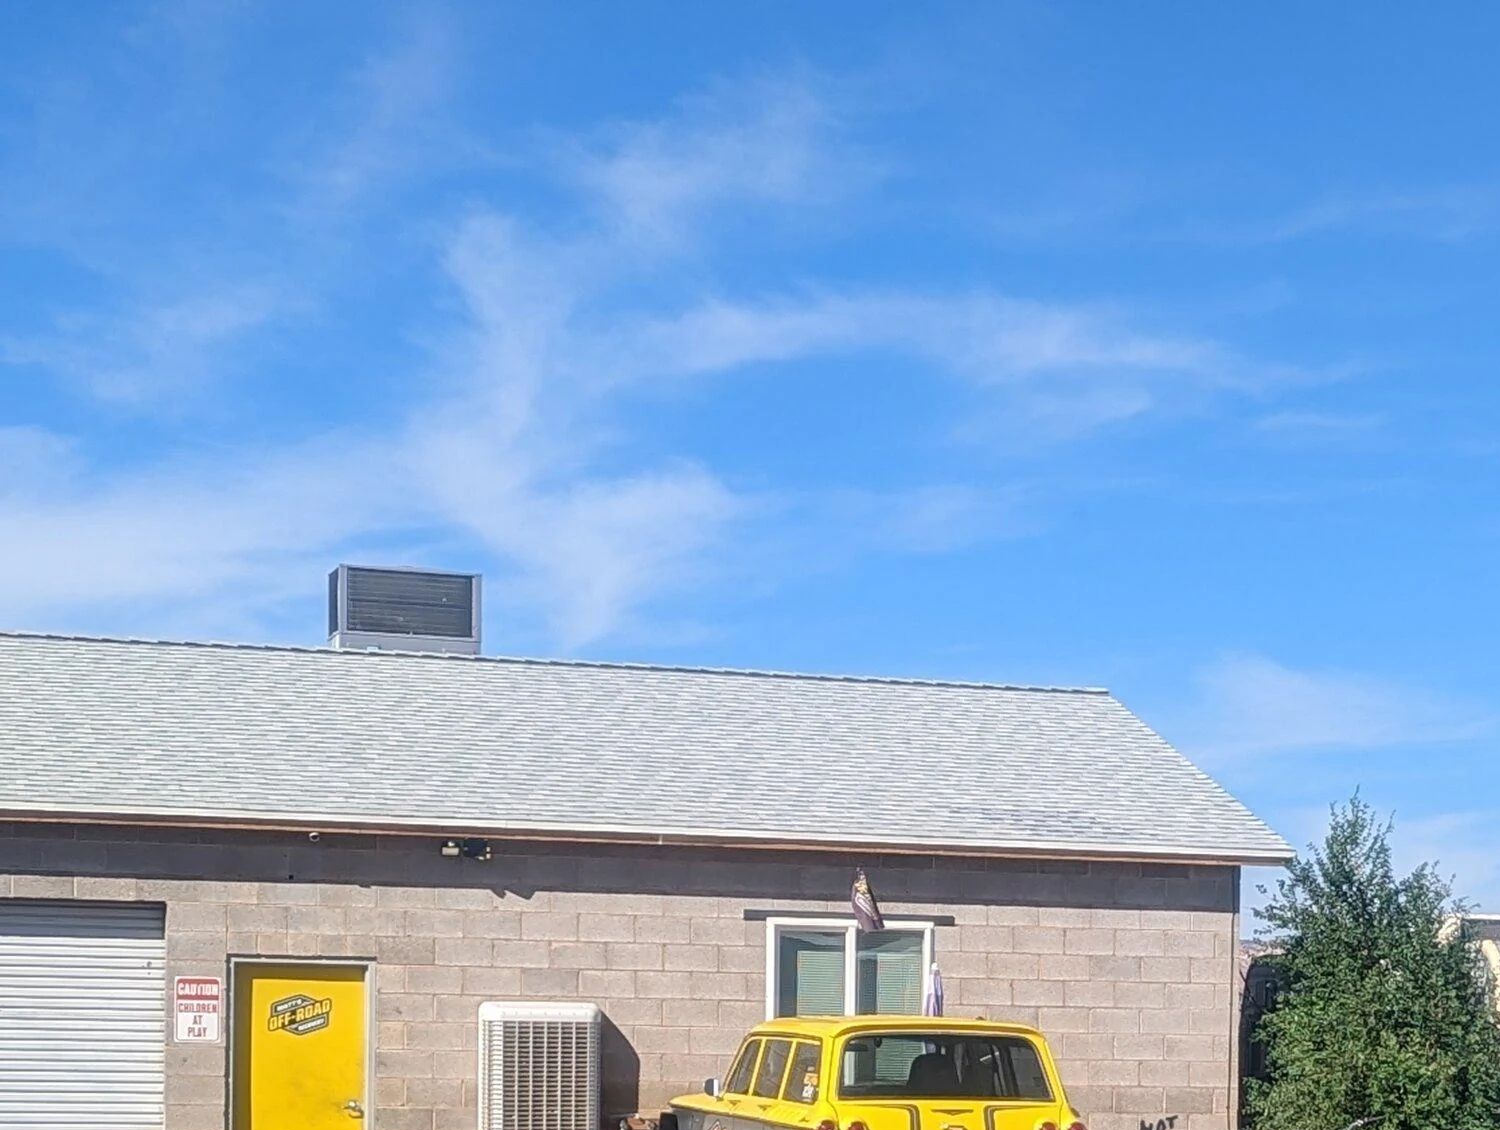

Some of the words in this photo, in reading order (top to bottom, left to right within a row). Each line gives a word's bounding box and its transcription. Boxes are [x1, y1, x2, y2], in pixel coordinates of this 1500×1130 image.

[178, 983, 218, 996] CAUTION
[178, 1002, 217, 1014] CHILDREN
[192, 1015, 203, 1025] AT
[269, 1000, 330, 1031] OFF-ROAD
[187, 1027, 207, 1038] PLAY
